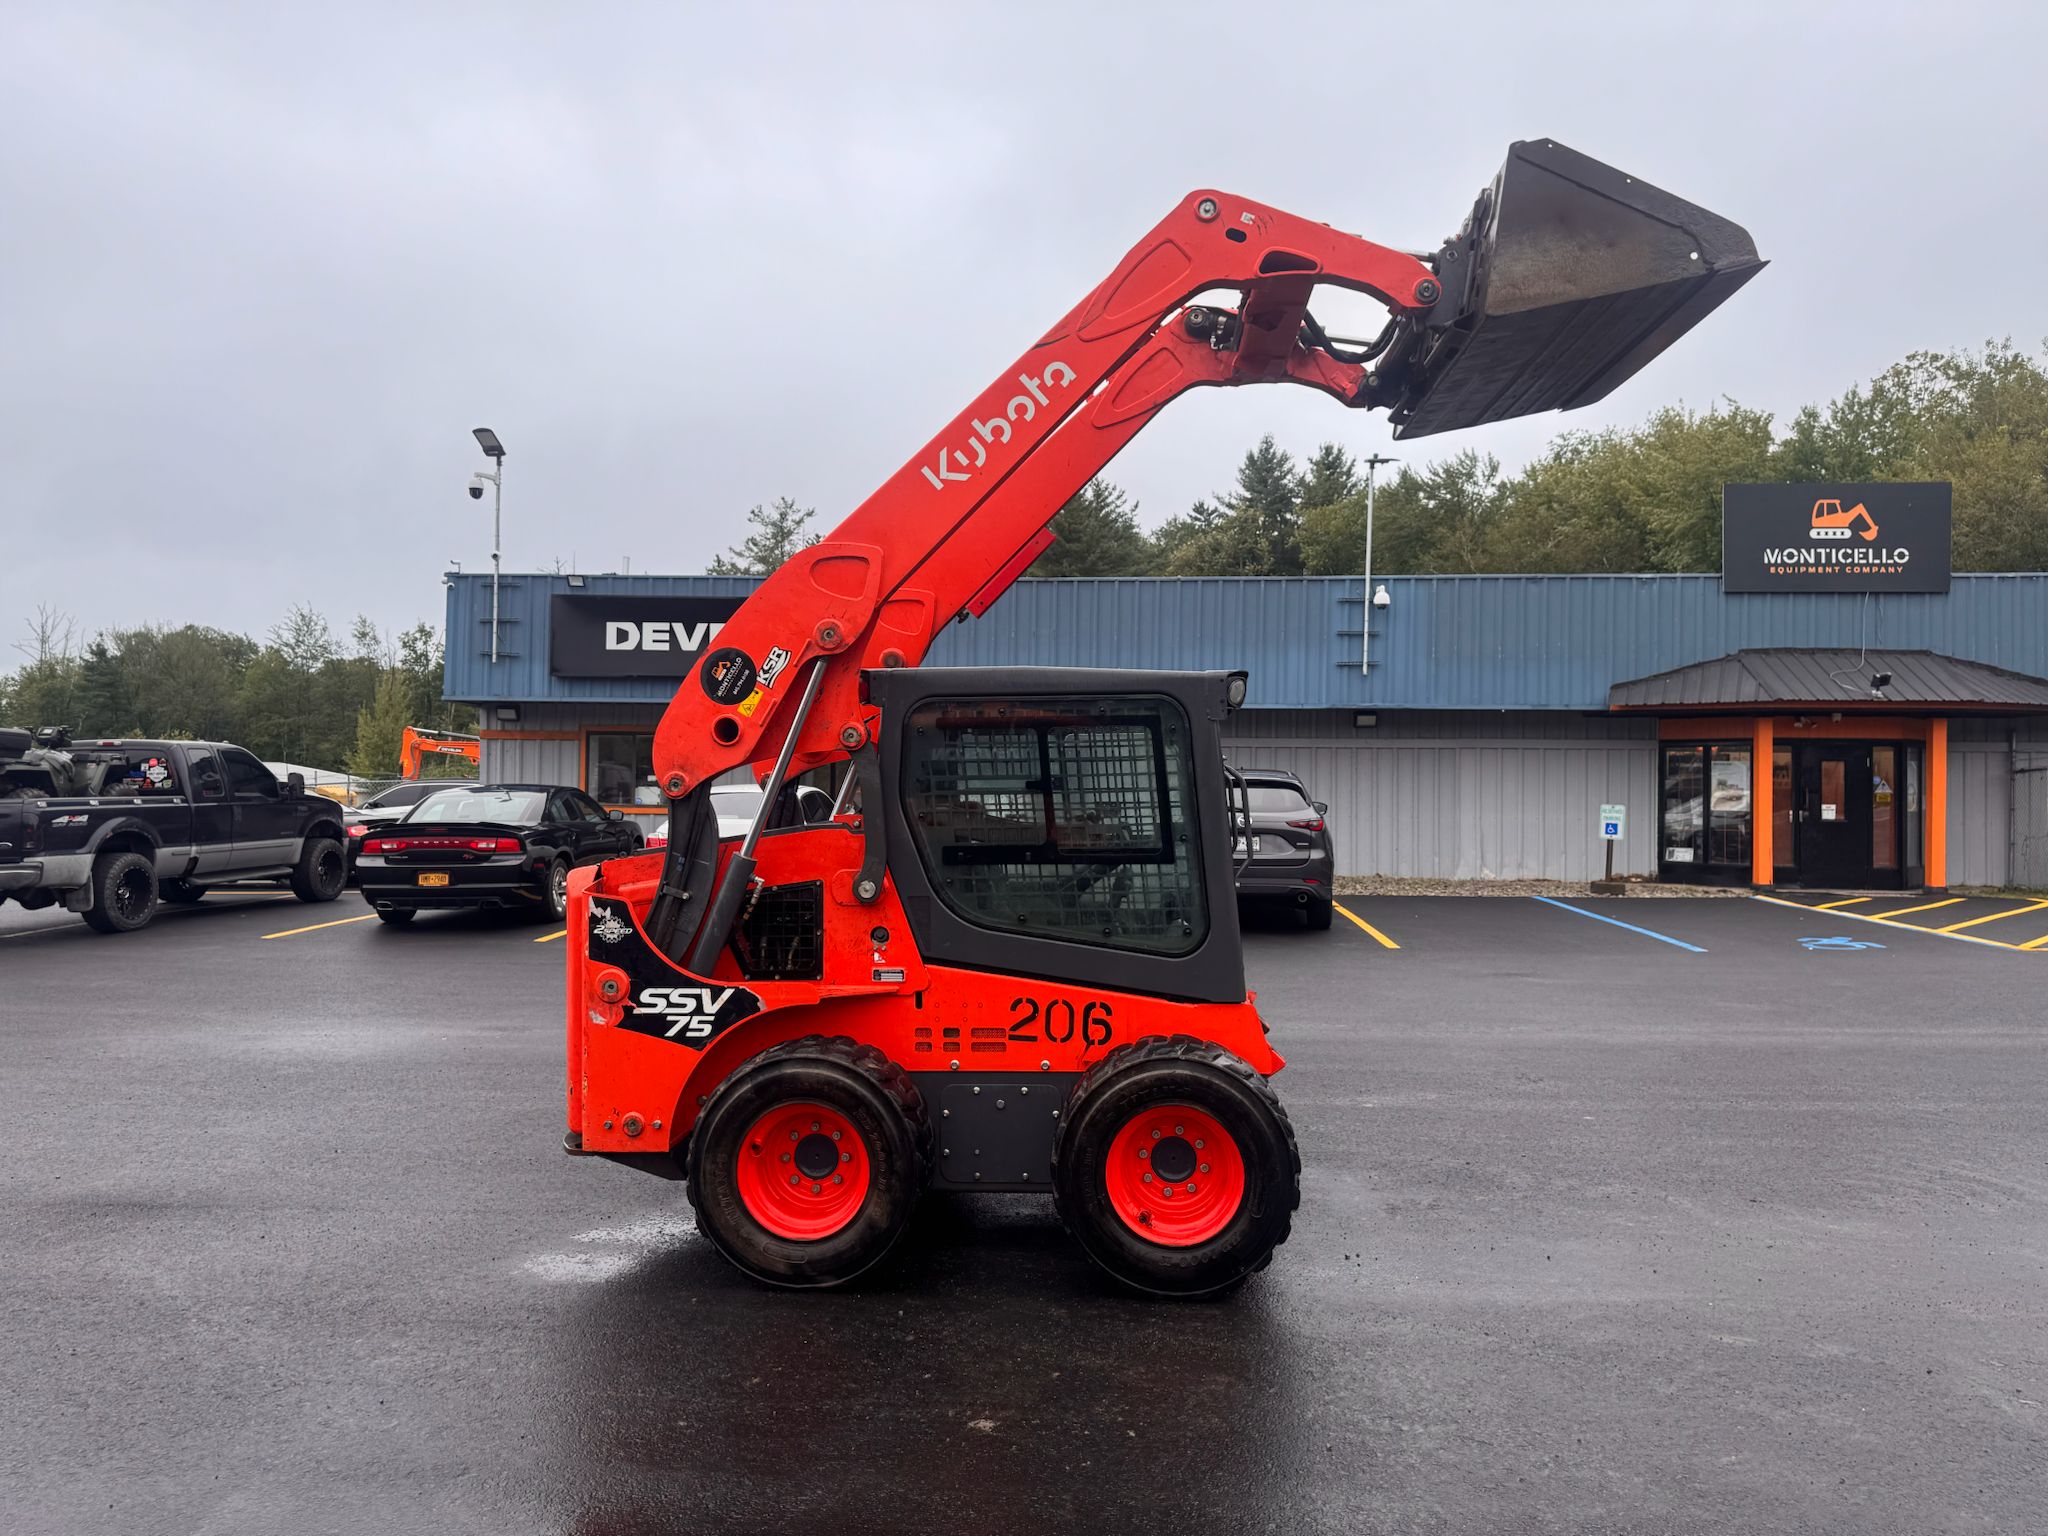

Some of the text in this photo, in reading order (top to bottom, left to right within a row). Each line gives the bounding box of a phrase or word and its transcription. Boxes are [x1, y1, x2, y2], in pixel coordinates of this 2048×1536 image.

[921, 361, 1077, 491] Kubota
[1763, 547, 1910, 565] MONTICELLO
[1769, 566, 1904, 575] EQUIPMENT COMPANY
[756, 646, 784, 686] KSR
[632, 988, 735, 1014] SSV
[664, 1015, 715, 1038] 75
[1008, 997, 1113, 1046] 206
